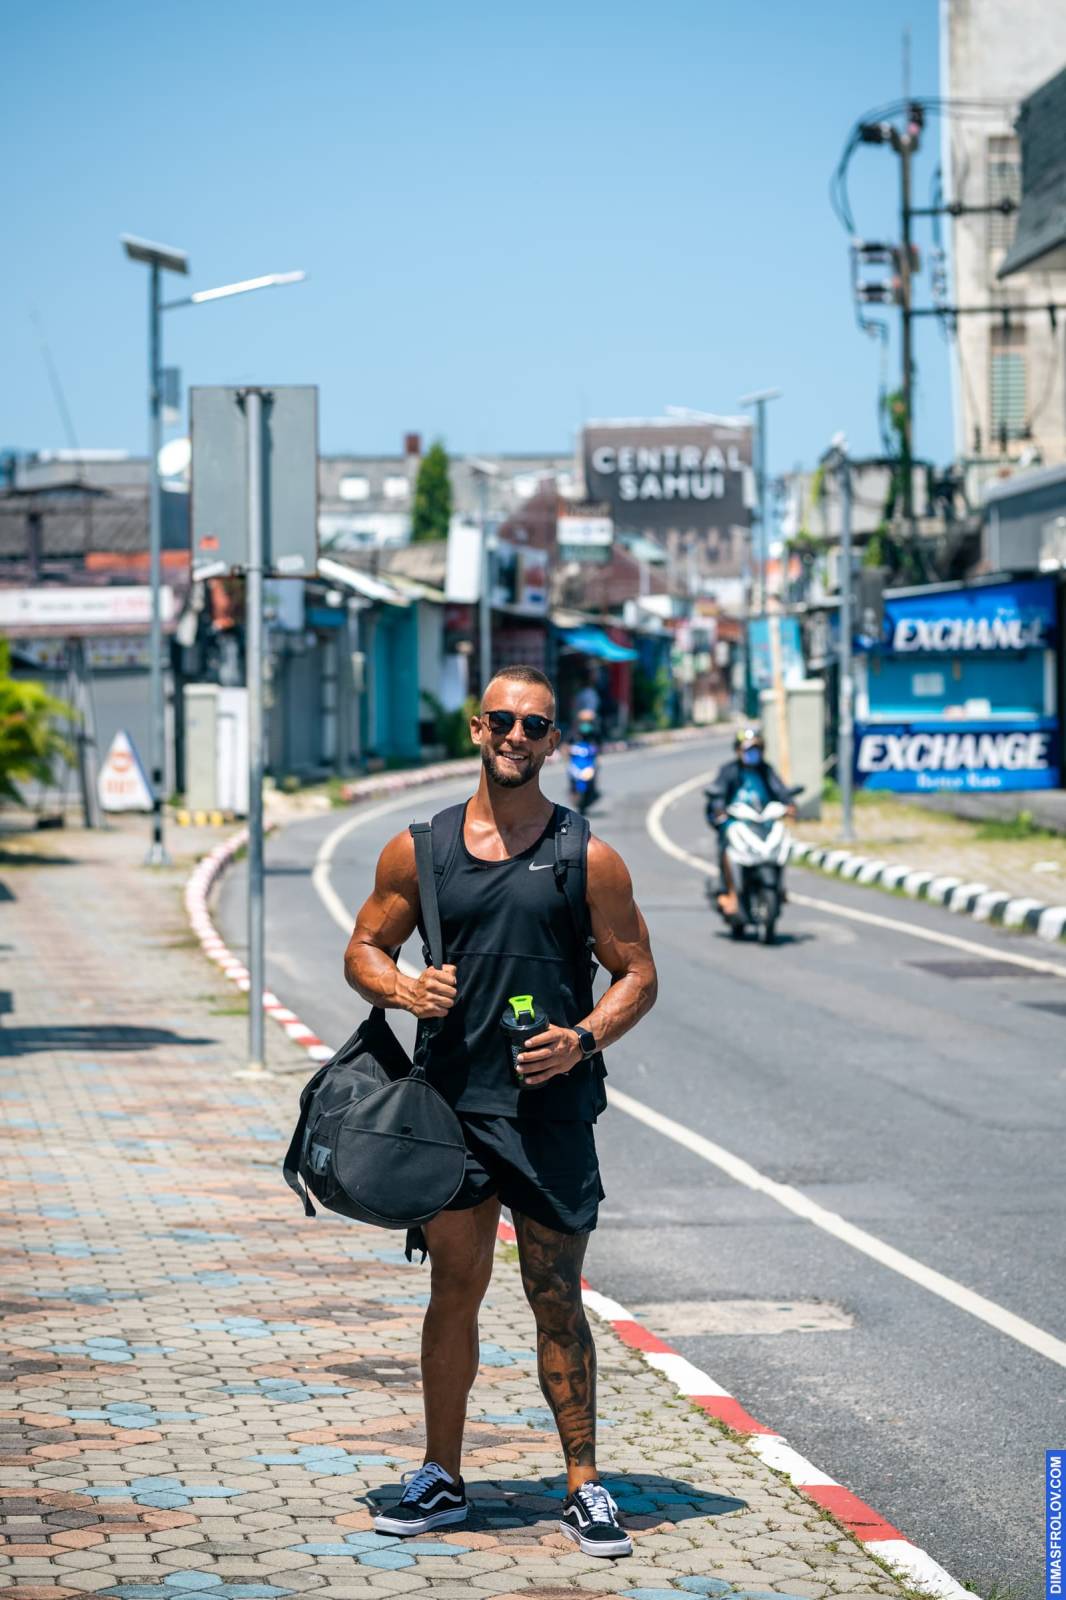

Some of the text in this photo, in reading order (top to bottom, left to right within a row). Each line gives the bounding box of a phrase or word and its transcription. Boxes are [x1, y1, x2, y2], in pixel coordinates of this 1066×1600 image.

[591, 446, 744, 474] CENTRAL
[618, 473, 725, 500] SAMUI
[856, 732, 1049, 772] EXCHANGE
